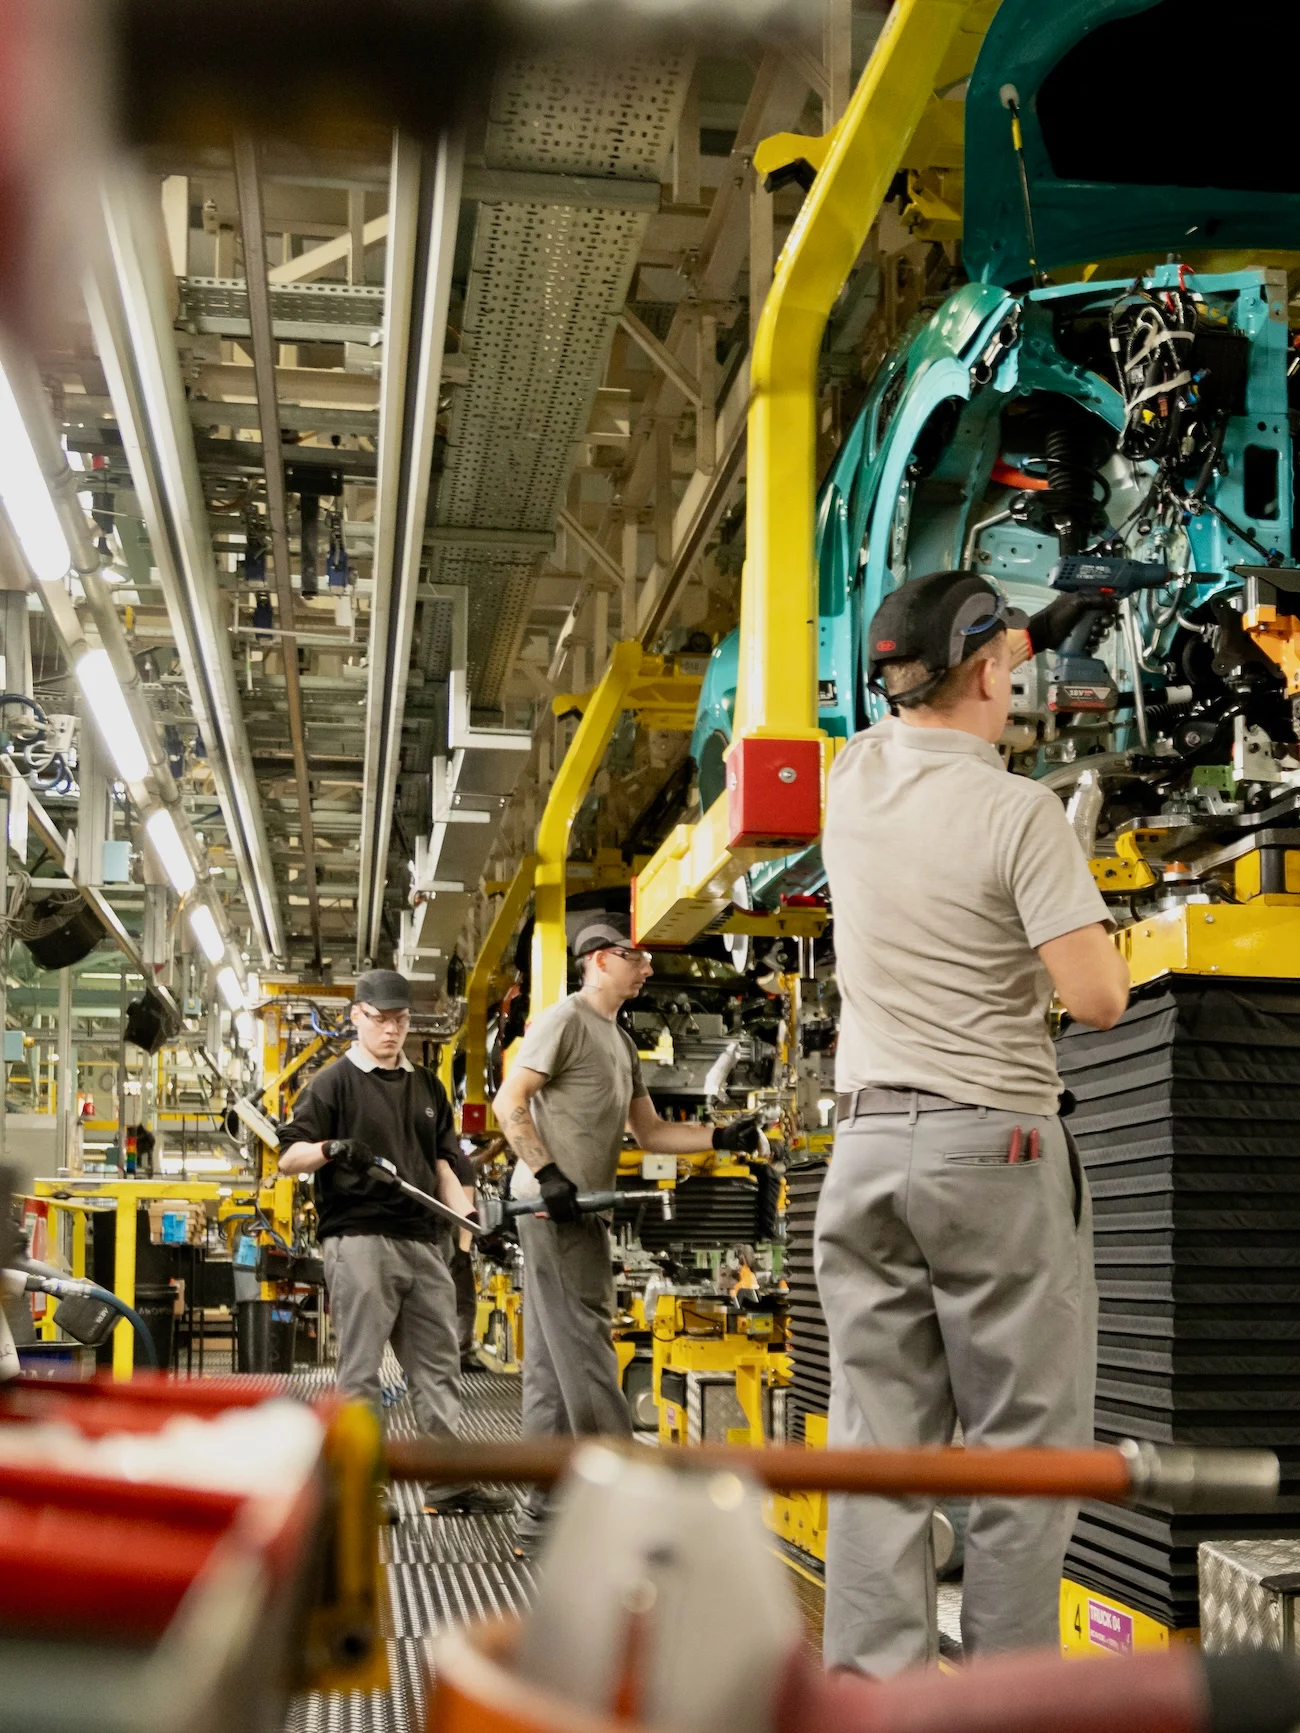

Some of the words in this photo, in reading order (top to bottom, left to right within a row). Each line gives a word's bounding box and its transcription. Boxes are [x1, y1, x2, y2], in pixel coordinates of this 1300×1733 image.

[95, 1307, 109, 1323] 10.8V
[1074, 1603, 1082, 1640] 4
[1089, 1604, 1112, 1628] TRUCK
[1112, 1613, 1121, 1633] 04
